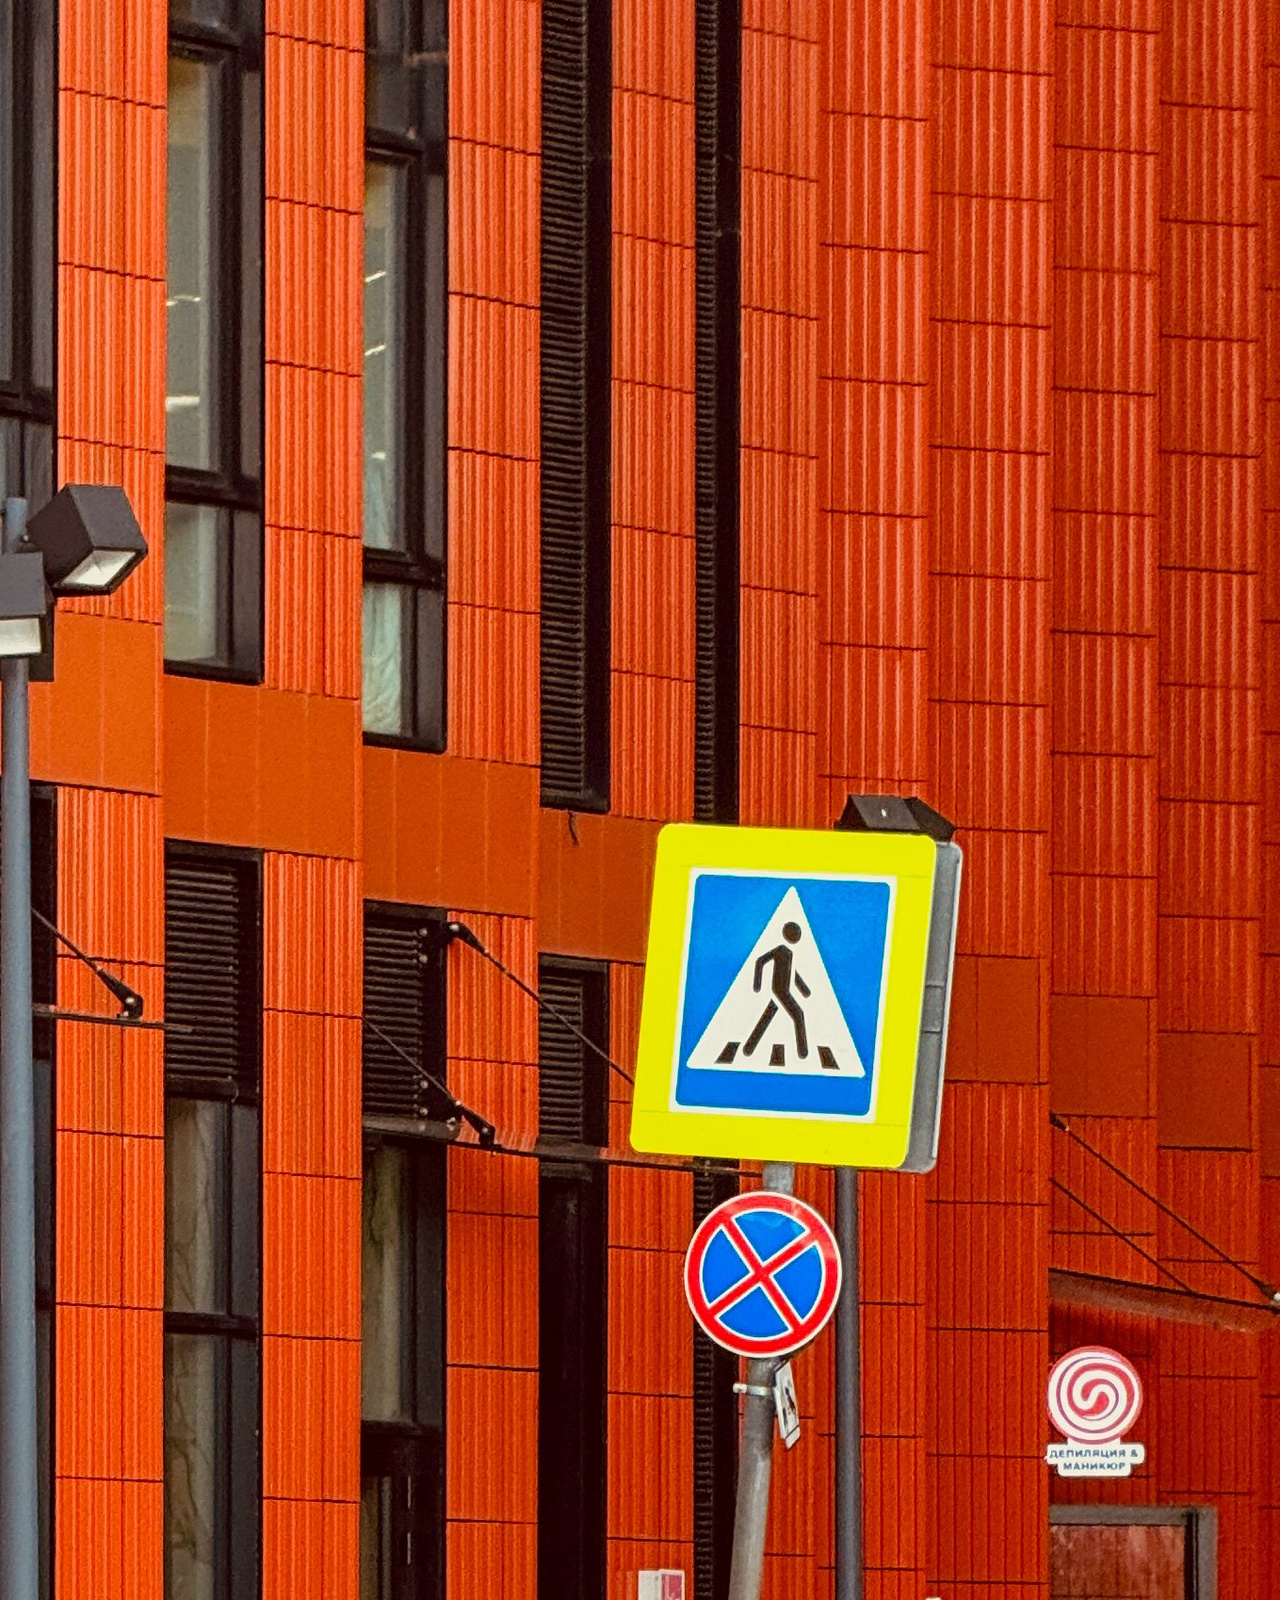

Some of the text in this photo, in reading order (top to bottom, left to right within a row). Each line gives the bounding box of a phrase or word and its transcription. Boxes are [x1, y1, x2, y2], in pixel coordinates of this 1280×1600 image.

[1049, 1448, 1139, 1459] ДЕПИЛЯЦИЯ &
[1063, 1462, 1126, 1471] МАНИКЮР
